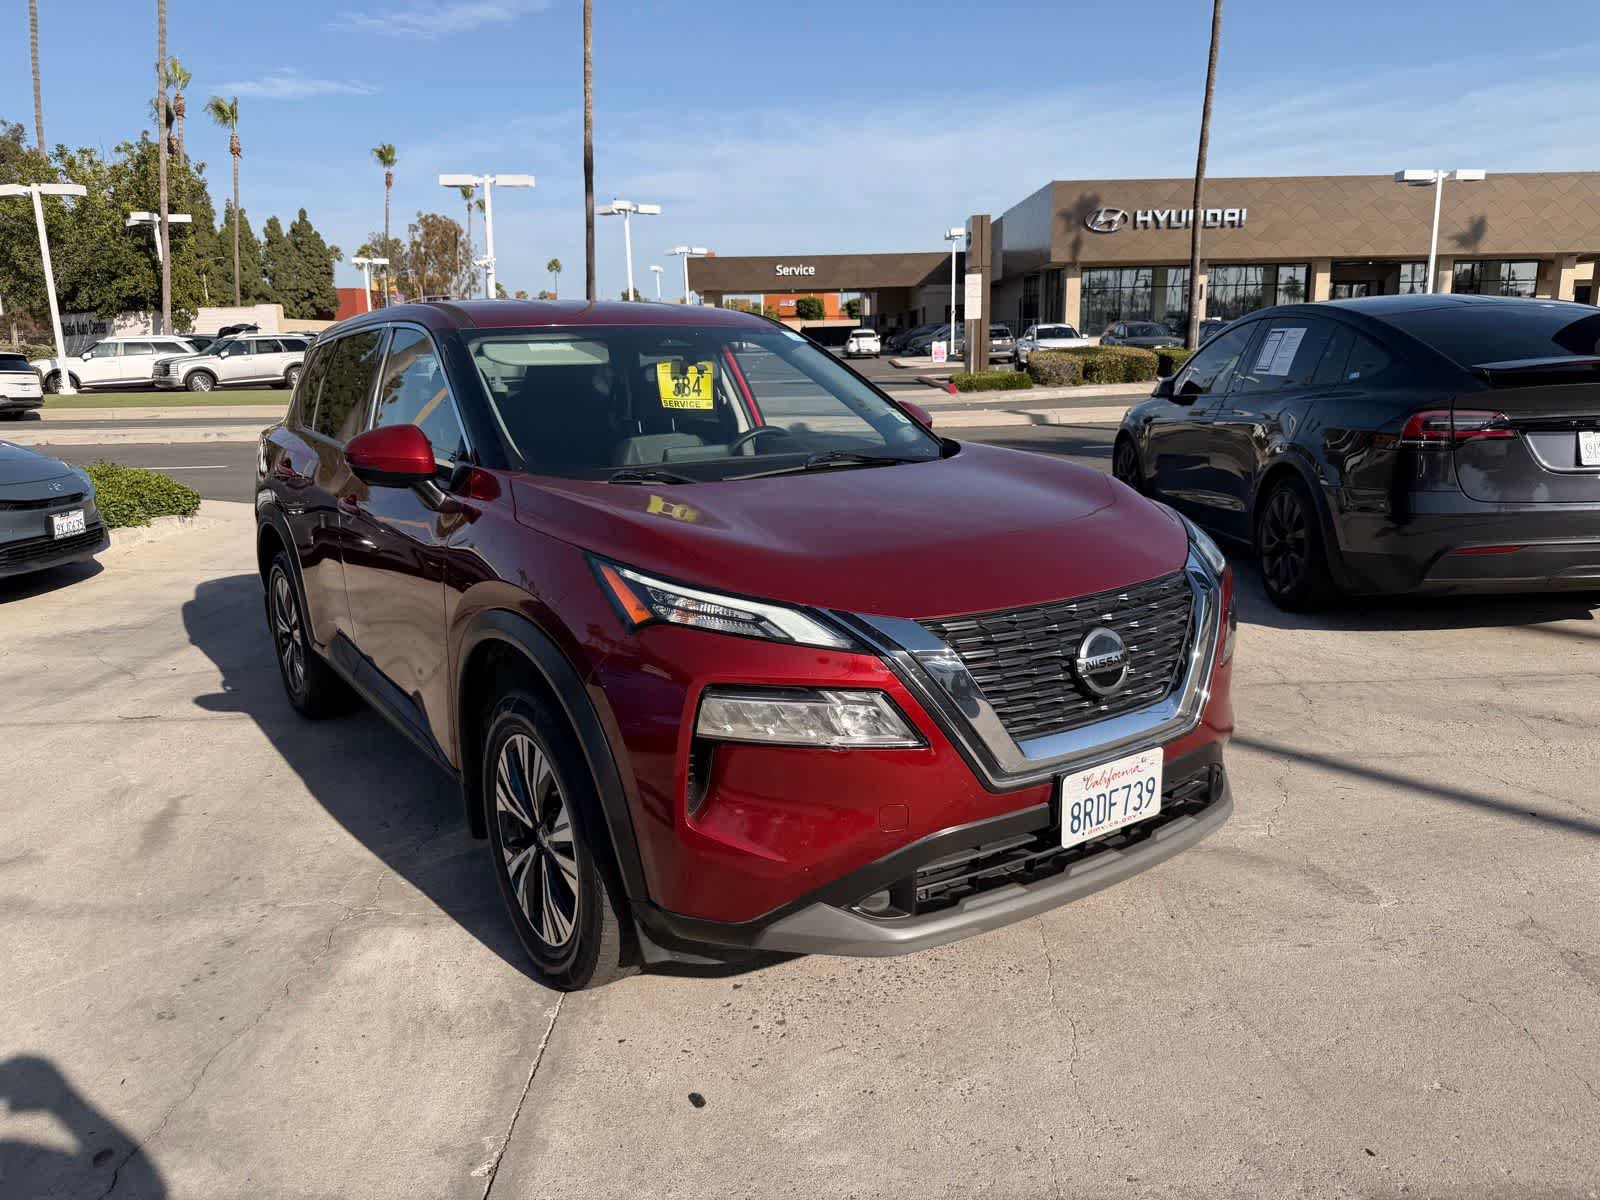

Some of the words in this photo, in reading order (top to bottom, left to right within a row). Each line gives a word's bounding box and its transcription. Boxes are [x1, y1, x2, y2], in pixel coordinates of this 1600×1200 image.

[776, 264, 816, 276] Service
[663, 400, 701, 408] SERVICE
[1085, 653, 1127, 671] NISSAN
[1084, 764, 1144, 791] California
[1070, 776, 1156, 834] 8RDF739
